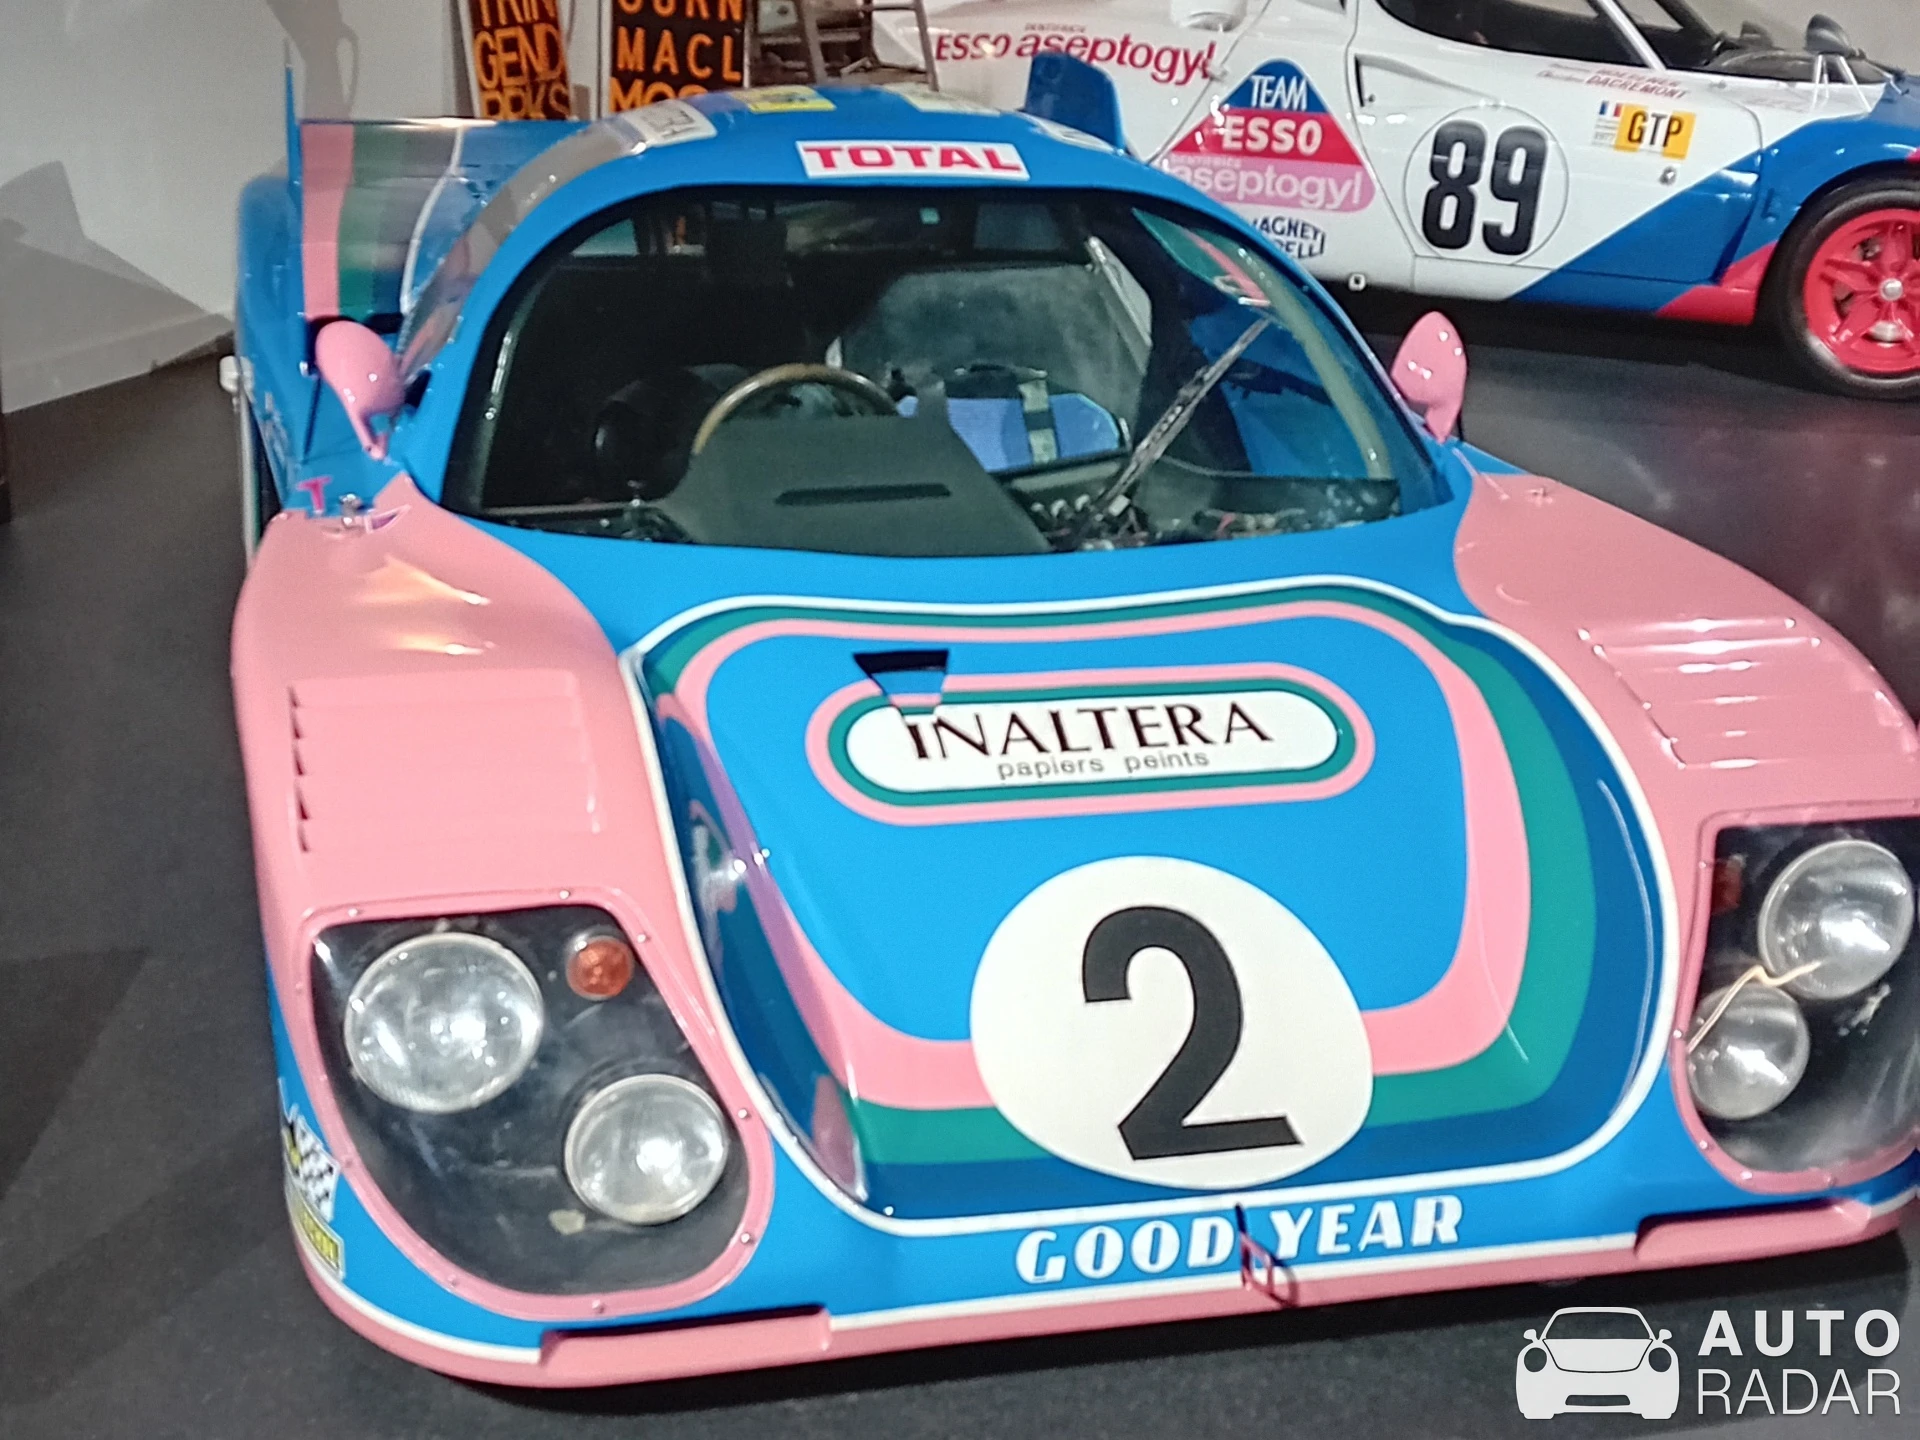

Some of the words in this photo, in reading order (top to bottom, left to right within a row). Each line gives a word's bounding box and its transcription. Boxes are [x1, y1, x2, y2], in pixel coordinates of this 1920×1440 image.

[474, 22, 566, 88] GEND
[617, 25, 742, 82] MACL
[935, 33, 1011, 60] ESSO
[1250, 75, 1308, 111] TEAM
[1221, 115, 1323, 156] ESSO
[1627, 110, 1684, 148] GTP
[803, 145, 1022, 173] TOTAL
[1421, 119, 1549, 256] 89
[906, 701, 1273, 760] INALTERA
[997, 757, 1105, 780] papiers
[1124, 751, 1210, 773] peints
[1082, 906, 1304, 1161] 2
[1016, 1217, 1235, 1284] GOOD
[1270, 1195, 1463, 1259] YEAR
